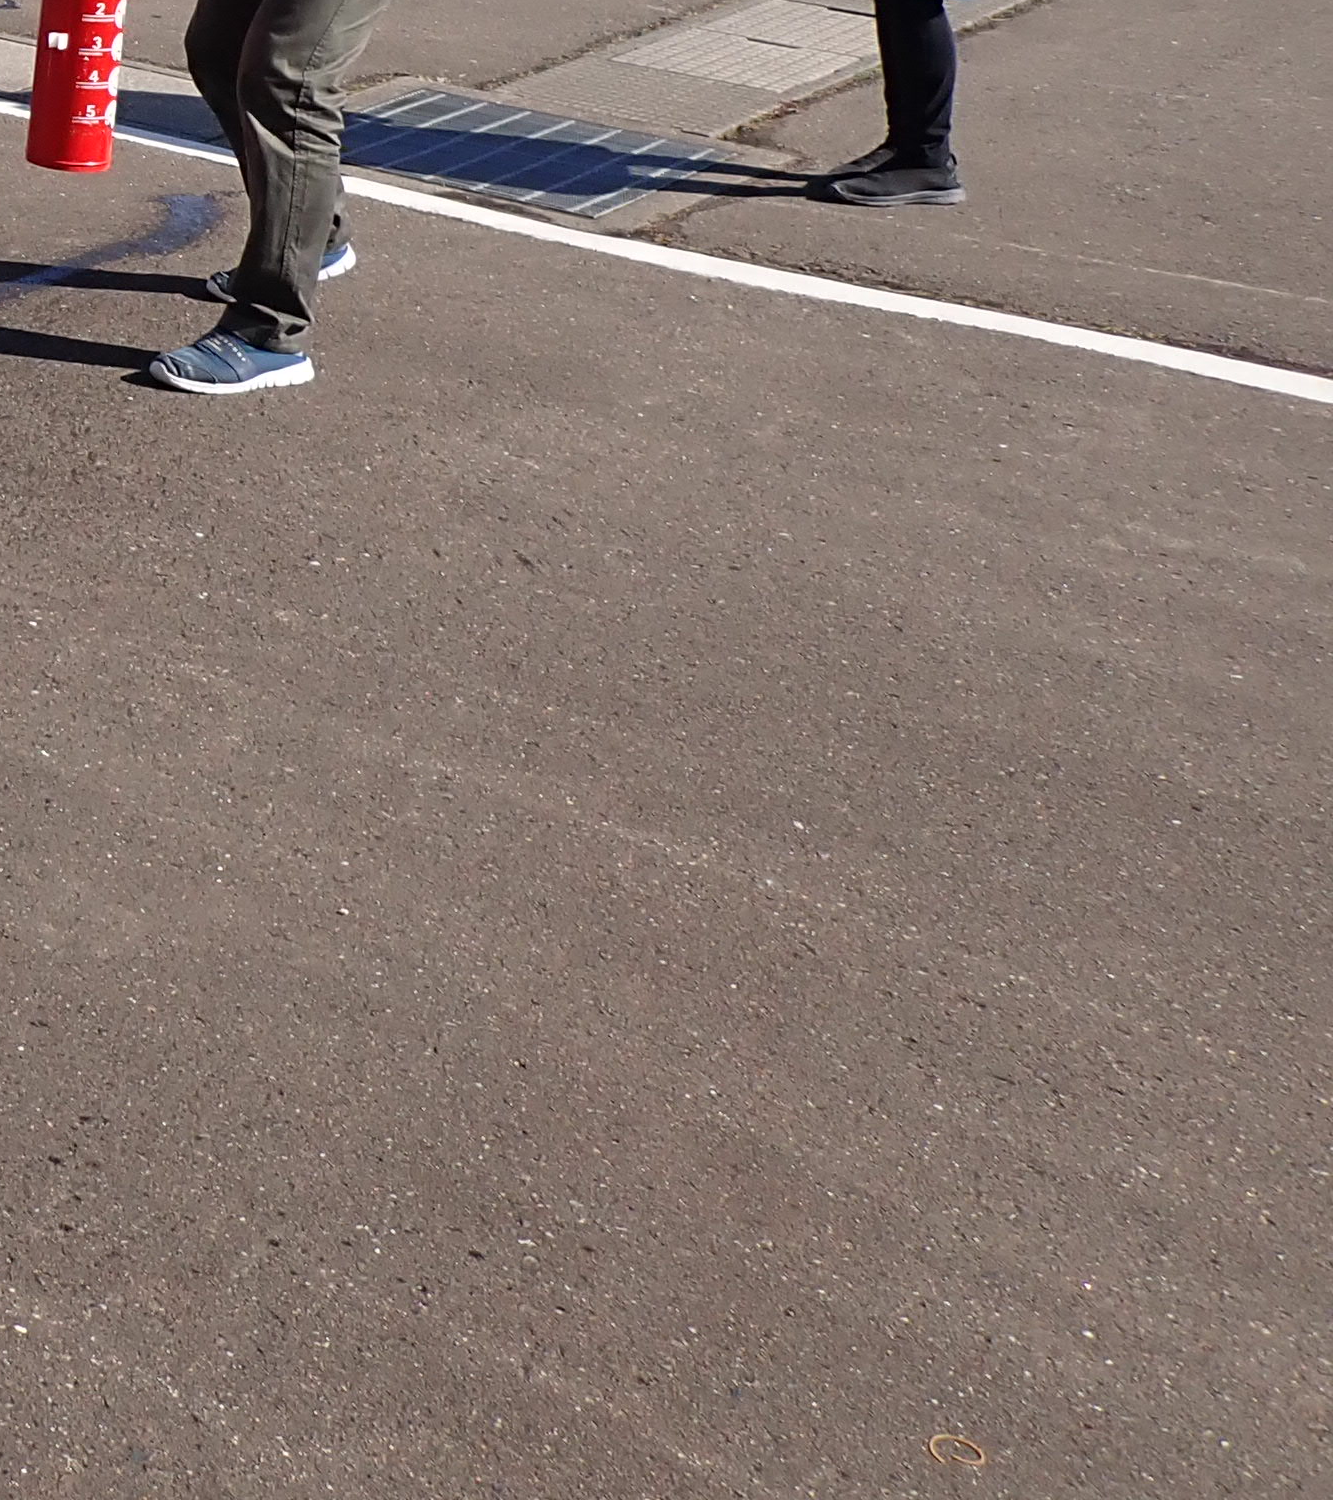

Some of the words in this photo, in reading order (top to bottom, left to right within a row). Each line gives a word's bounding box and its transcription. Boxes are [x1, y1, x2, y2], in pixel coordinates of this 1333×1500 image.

[95, 2, 106, 15] 2
[92, 36, 103, 49] 3
[88, 70, 100, 82] 4
[85, 104, 96, 117] 5
